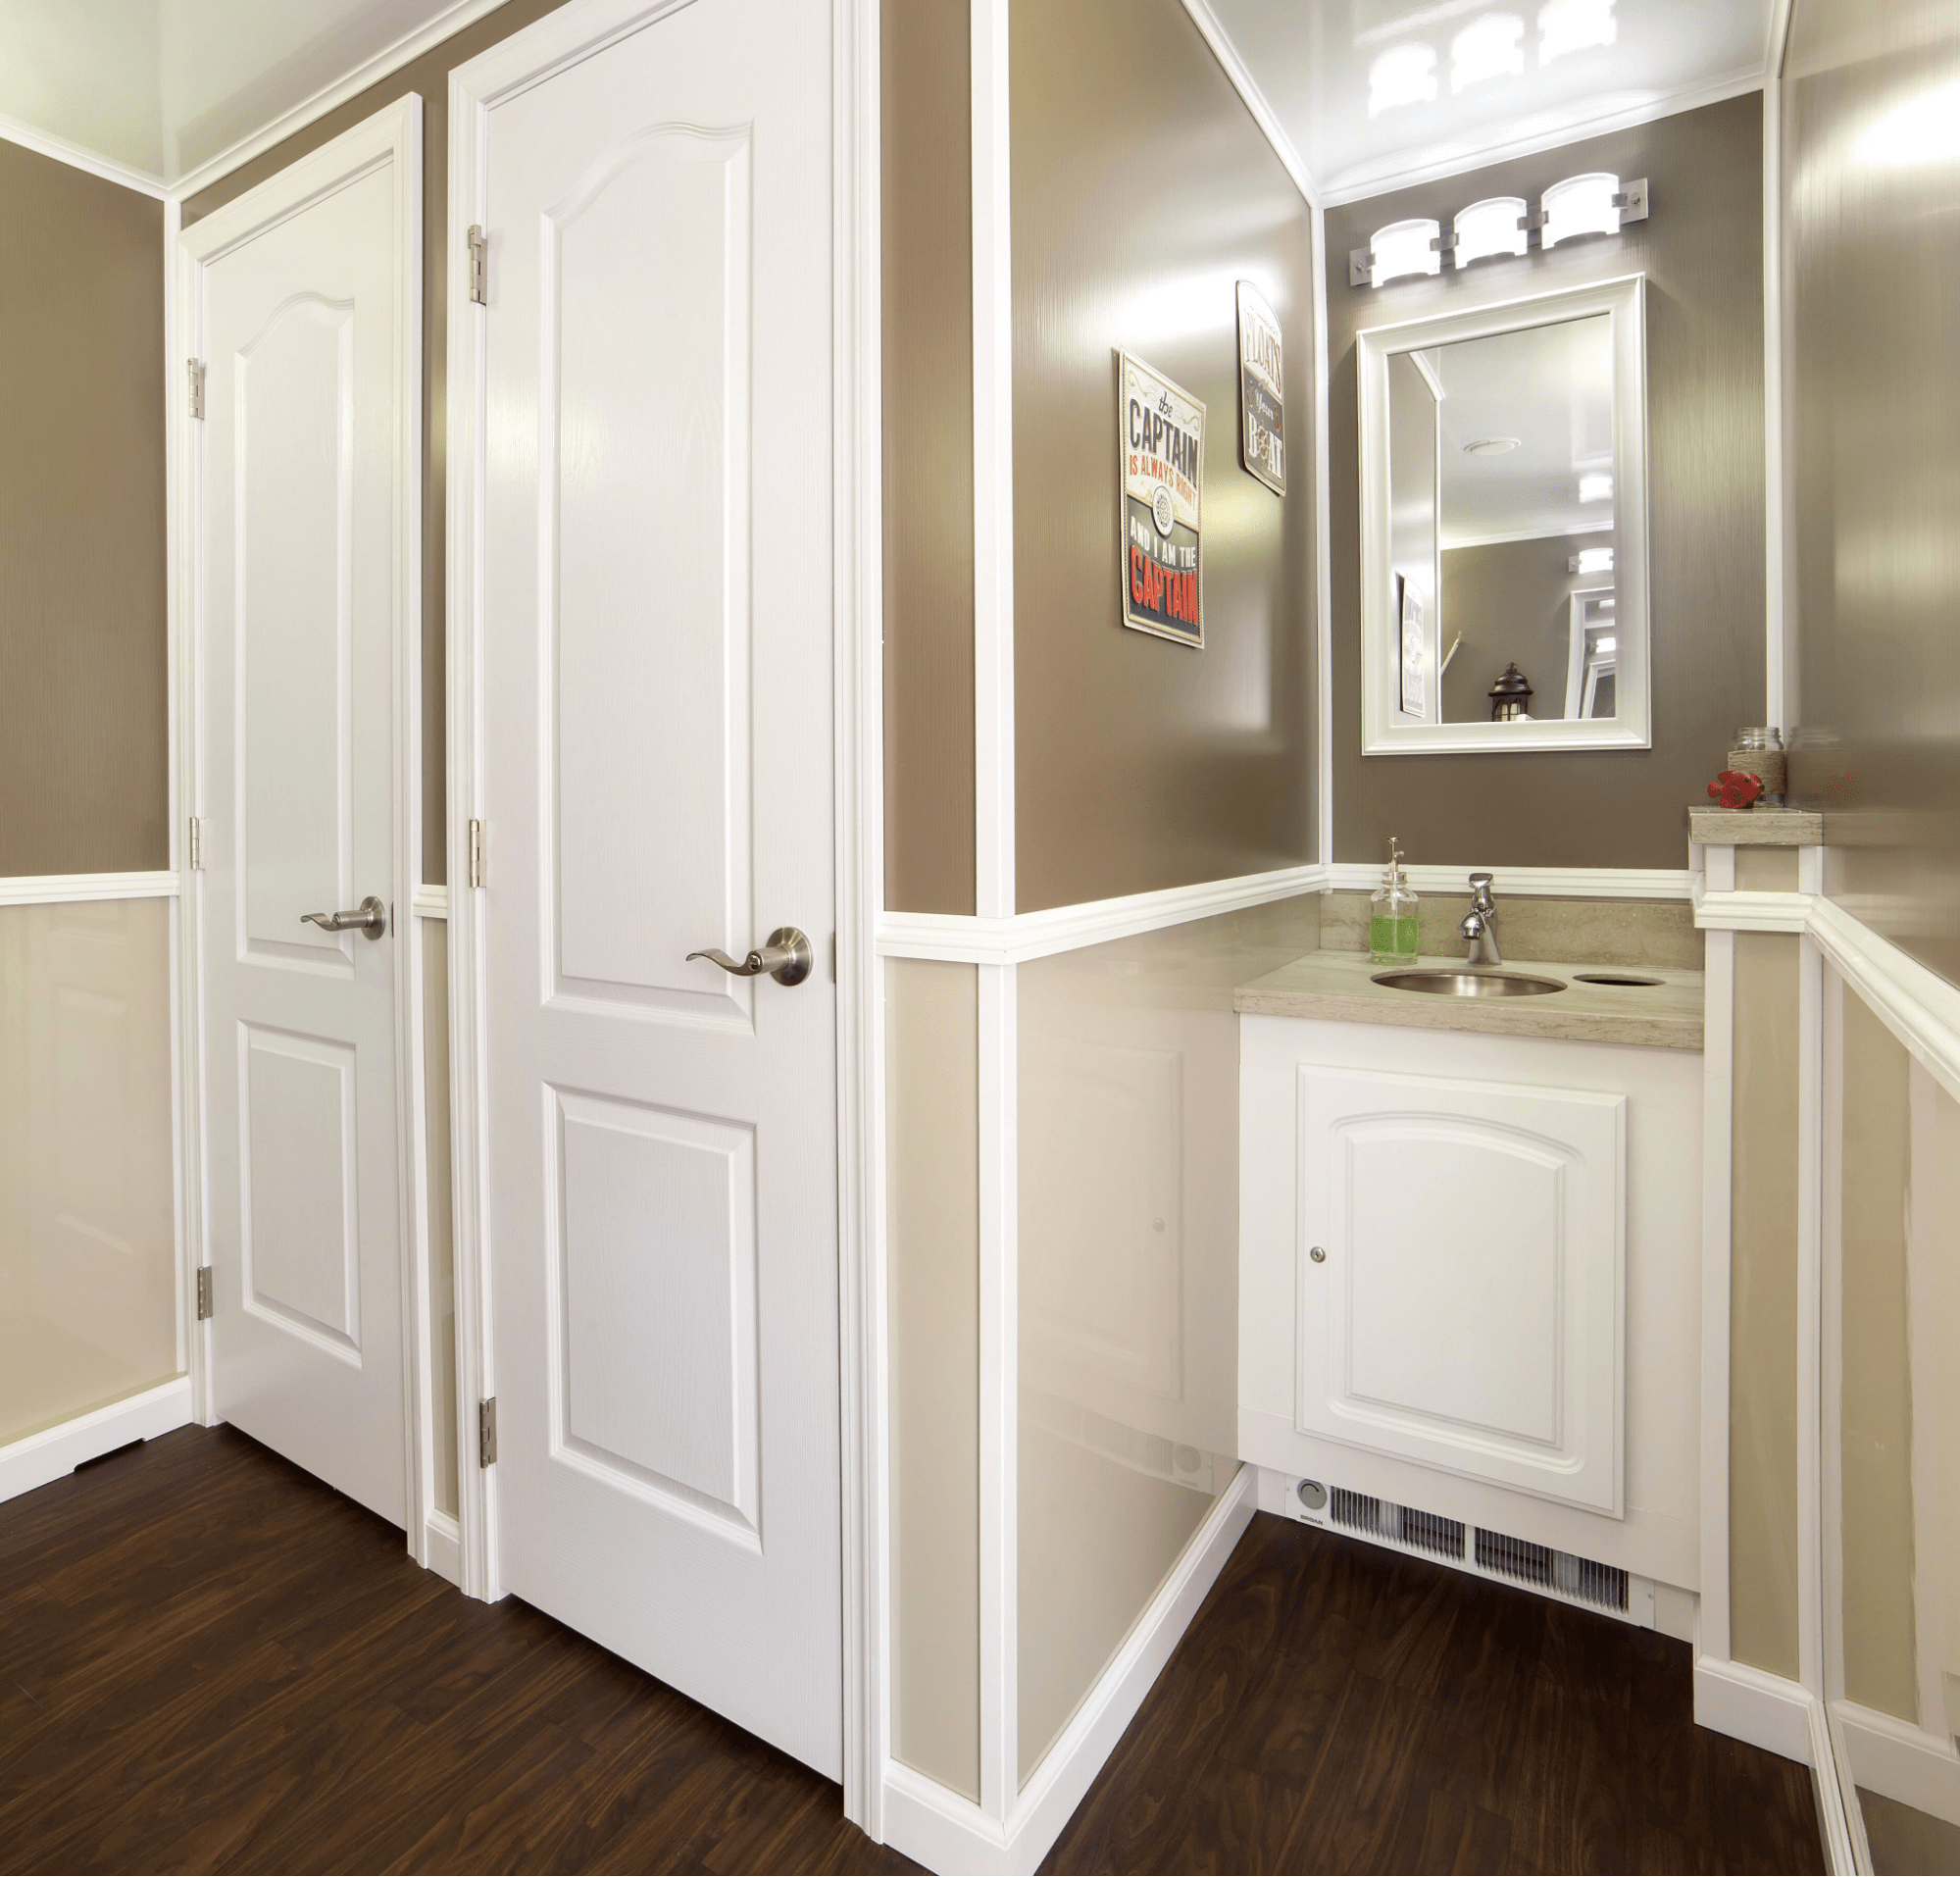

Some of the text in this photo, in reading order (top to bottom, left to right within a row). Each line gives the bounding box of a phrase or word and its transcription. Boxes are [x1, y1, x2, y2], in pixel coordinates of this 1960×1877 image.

[1158, 391, 1174, 419] the
[1130, 398, 1198, 486] CAPTAIN
[1130, 455, 1196, 511] IS ALWAYS RIGHT
[1131, 516, 1196, 568] AND I AM THE
[1131, 545, 1197, 625] CAPTAIN
